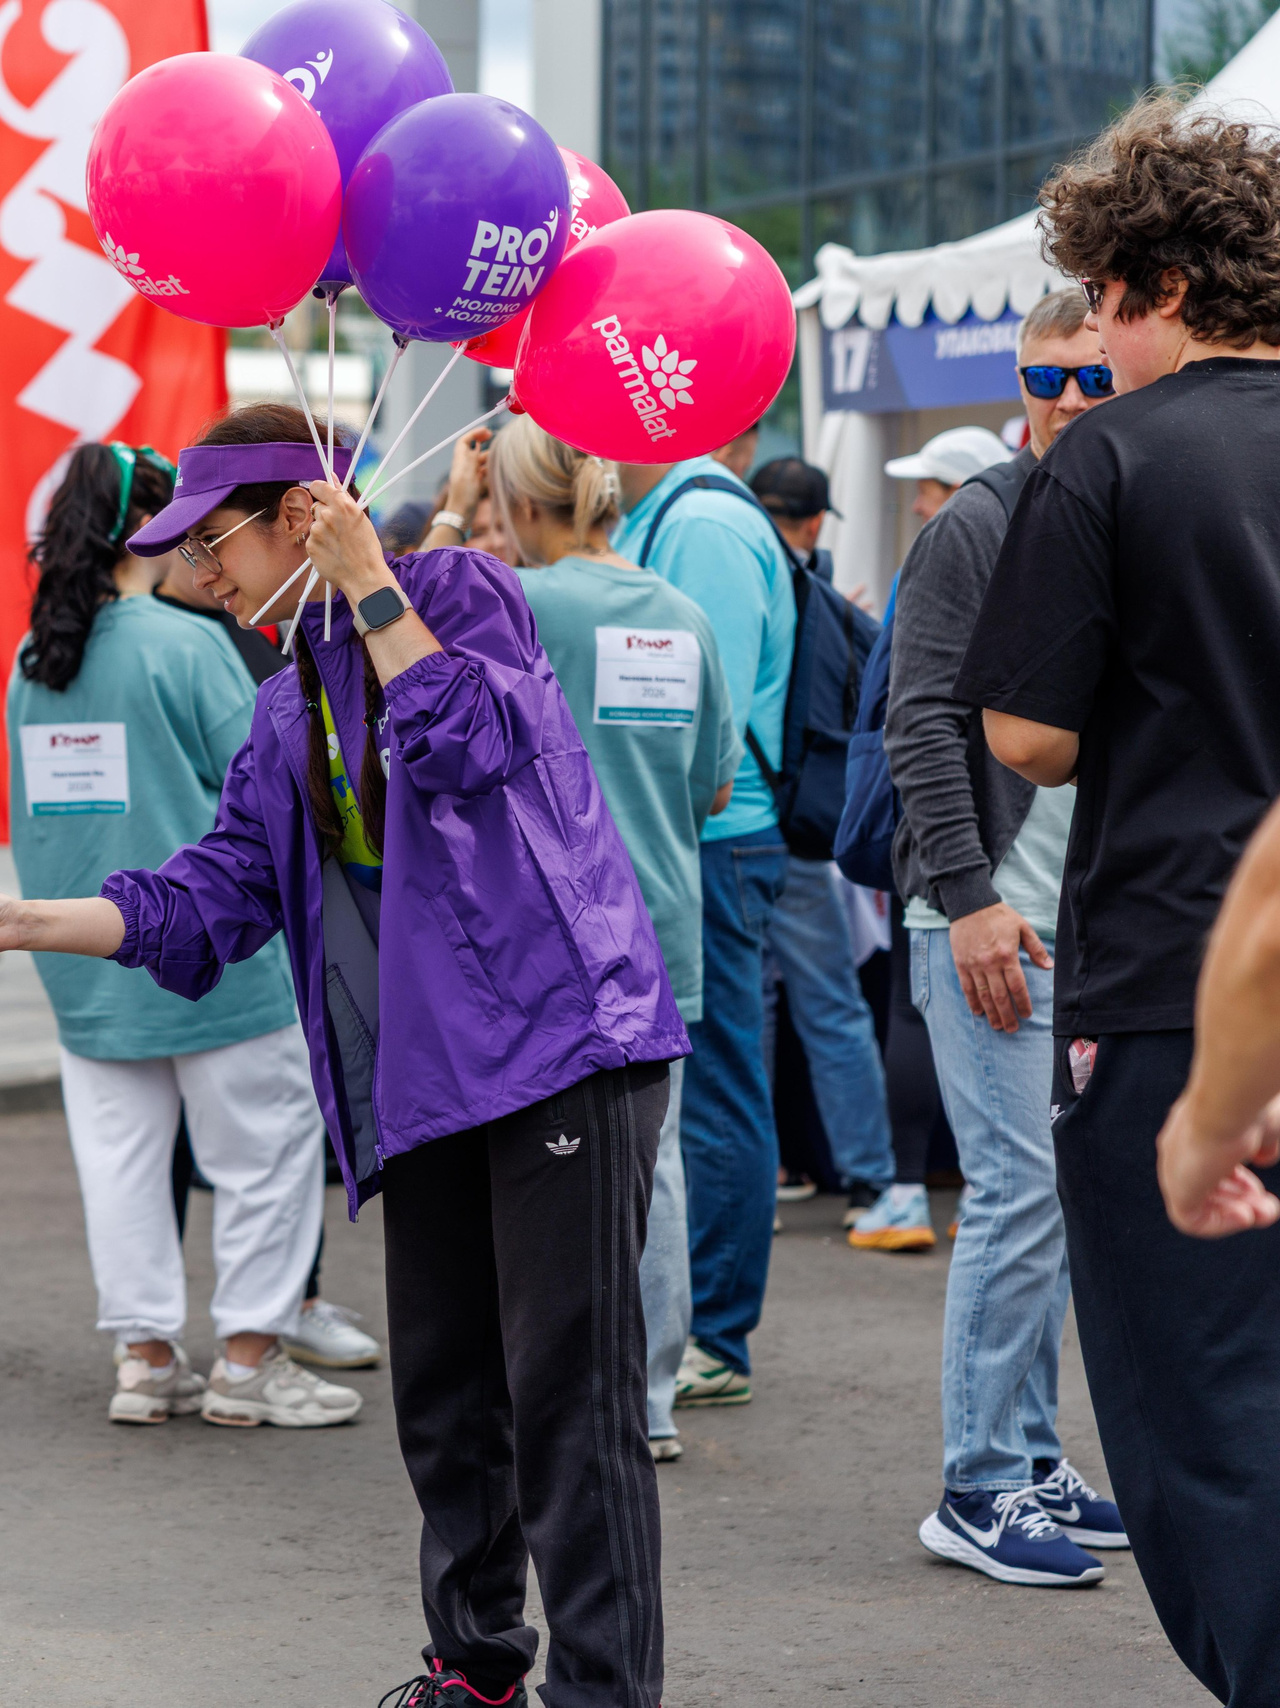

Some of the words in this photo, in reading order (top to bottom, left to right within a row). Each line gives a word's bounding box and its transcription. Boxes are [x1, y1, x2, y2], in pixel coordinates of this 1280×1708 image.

[470, 220, 549, 265] PRO
[462, 259, 545, 297] TEIN
[452, 297, 521, 313] МОЛОКО
[591, 314, 677, 442] parmalat
